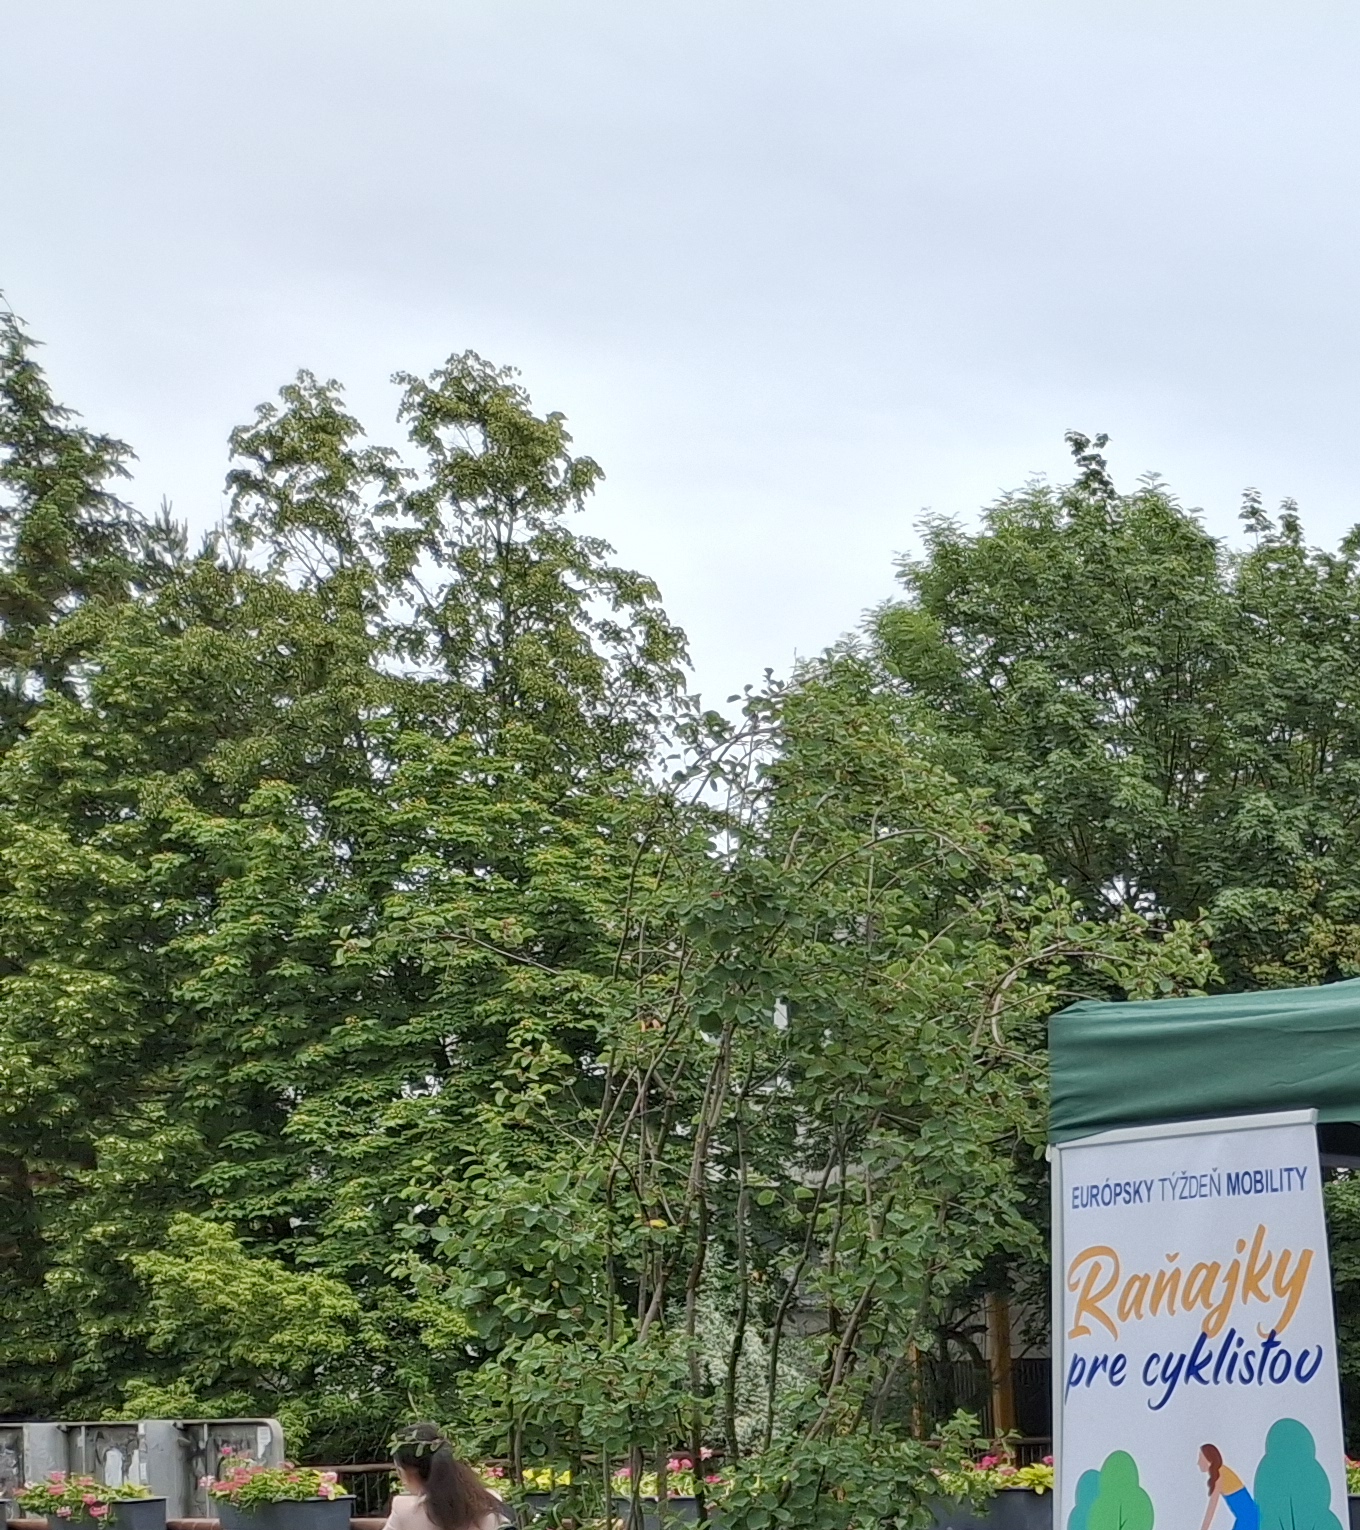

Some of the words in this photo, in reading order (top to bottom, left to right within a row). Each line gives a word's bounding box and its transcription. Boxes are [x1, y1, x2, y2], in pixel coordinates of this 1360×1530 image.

[1071, 1178, 1155, 1209] EURÓPSKY
[1157, 1168, 1222, 1201] TÝŽDEŇ
[1226, 1165, 1308, 1198] MOBILITY
[1066, 1223, 1315, 1342] Raňajky
[1064, 1351, 1128, 1406] pre
[1141, 1327, 1324, 1412] cyklistov
